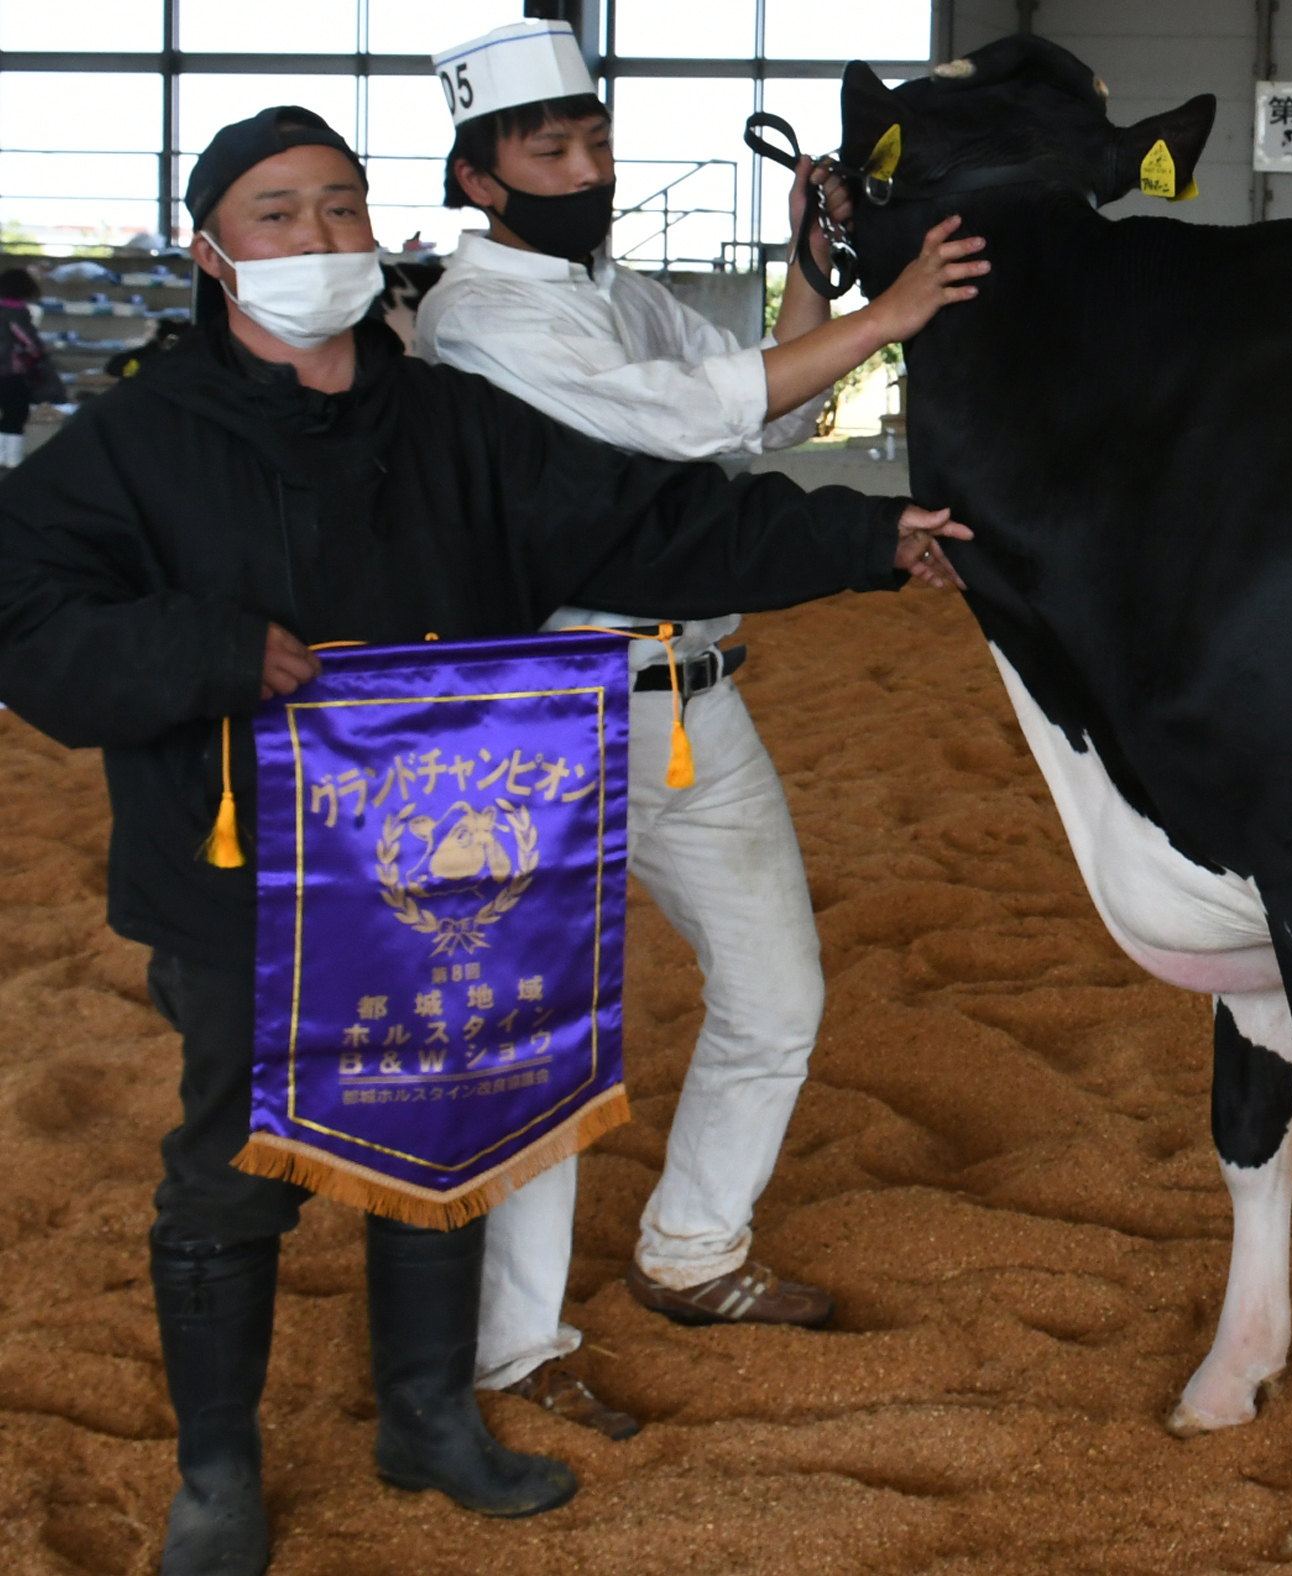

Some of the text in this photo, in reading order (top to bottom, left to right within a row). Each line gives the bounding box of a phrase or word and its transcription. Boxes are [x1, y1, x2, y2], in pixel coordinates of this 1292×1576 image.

[311, 748, 597, 828] グランドチャンピオン
[343, 1006, 554, 1048] ホルスタイン
